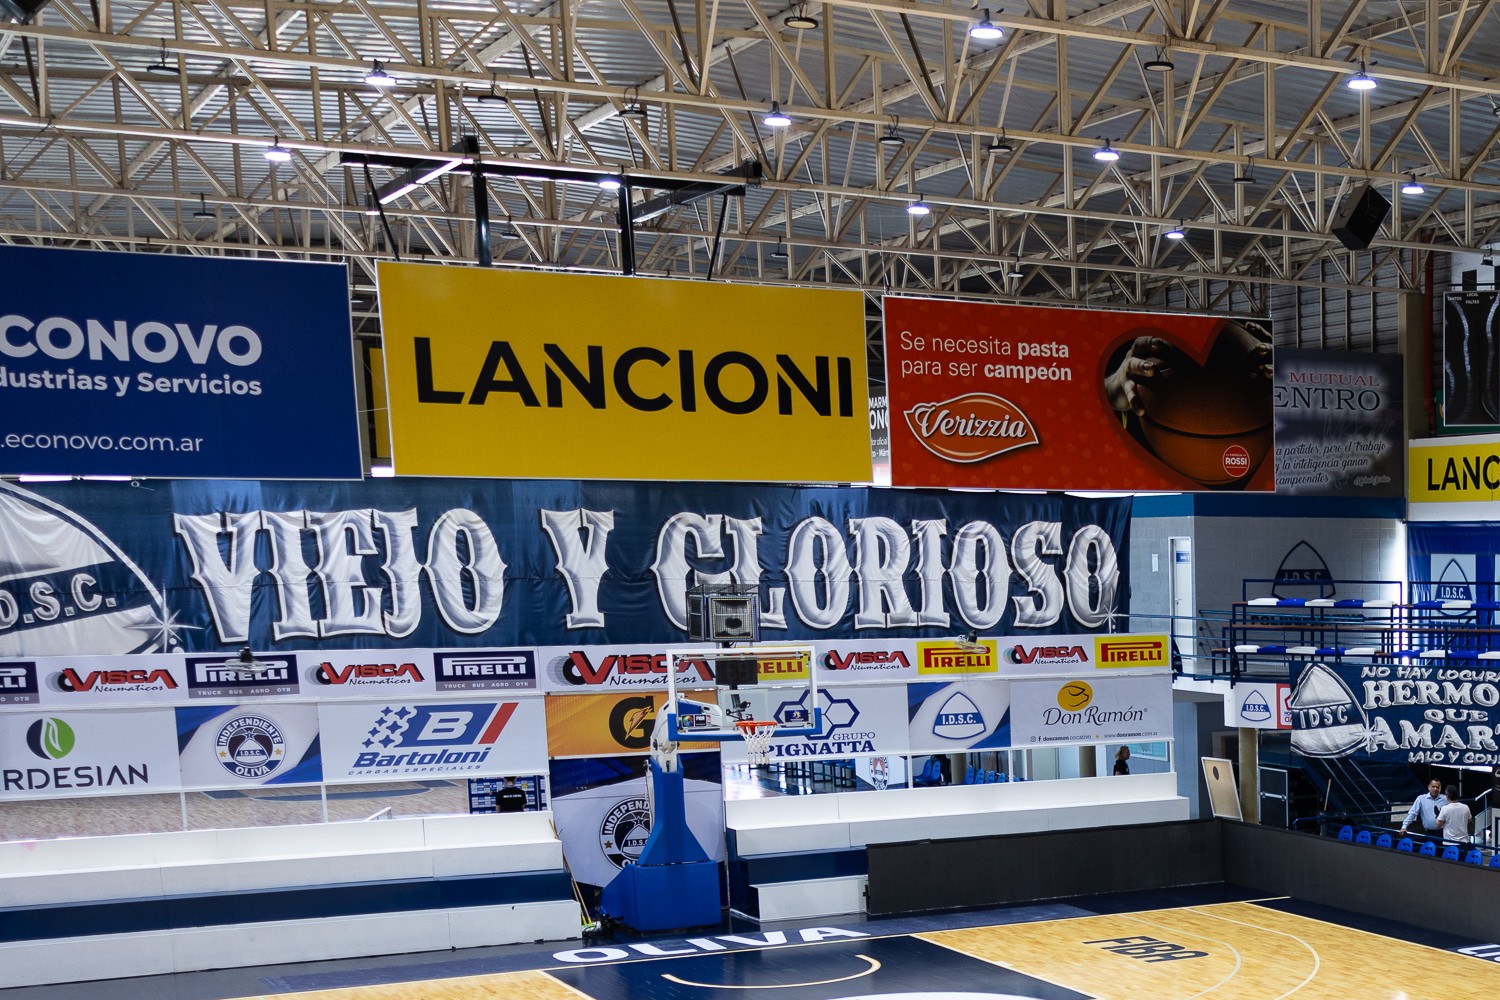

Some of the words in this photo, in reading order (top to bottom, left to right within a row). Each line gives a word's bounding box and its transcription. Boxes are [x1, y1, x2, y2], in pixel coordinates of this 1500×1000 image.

[900, 331, 925, 351] Se
[932, 336, 1011, 356] necesita
[1017, 341, 1069, 360] pasta
[413, 336, 853, 418] LANCIONI
[901, 360, 942, 378] para
[948, 362, 978, 377] ser
[983, 363, 1072, 383] campeón
[1289, 372, 1380, 387] MUTUAL
[114, 376, 130, 397] y
[137, 372, 263, 396] Servicios
[1274, 385, 1381, 412] ENTRO
[914, 407, 1027, 438] Verizzia
[1322, 446, 1342, 457] pero
[1344, 440, 1352, 452] el
[1354, 440, 1387, 458] trabajo
[1225, 457, 1248, 466] ROSSI
[1282, 460, 1291, 470] la
[1293, 458, 1339, 472] inteligencia
[1341, 458, 1369, 471] ganan
[172, 507, 508, 643] VIEJO
[539, 507, 614, 630] Y
[650, 510, 1120, 632] GLORIOSO
[1441, 586, 1466, 599] I.D.S.C.
[923, 645, 991, 669] PIRELLI
[1034, 656, 1080, 665] Neumaticos
[1100, 641, 1163, 663] PIRELLI
[195, 660, 289, 683] PIRELLI
[442, 655, 527, 678] PIRELLI
[850, 663, 901, 672] Neumaticos
[1361, 666, 1391, 678] NO
[1396, 666, 1432, 679] HAY
[95, 684, 164, 693] Neumaticos
[349, 675, 412, 687] Neumaticos
[609, 674, 698, 687] Neumatcos
[250, 687, 270, 695] AGRO
[1043, 707, 1082, 726] Don
[1084, 705, 1144, 727] Ramón
[1246, 704, 1266, 712] I.D.S.C.
[1299, 705, 1348, 729] IDSC
[1423, 708, 1489, 723] QUE
[942, 712, 977, 726] I.D.S.C.
[218, 717, 282, 746] INDEPENDIENTE
[832, 732, 876, 741] GRUPO
[352, 746, 492, 769] Bartoloni
[767, 739, 877, 758] PIGNATTA
[1449, 751, 1460, 762] Y
[235, 765, 271, 777] OLIVA
[348, 768, 391, 776] CARGAS
[404, 765, 482, 774] ESPECIALES
[552, 926, 871, 964] OLIVA
[1082, 936, 1209, 963] FIBA
